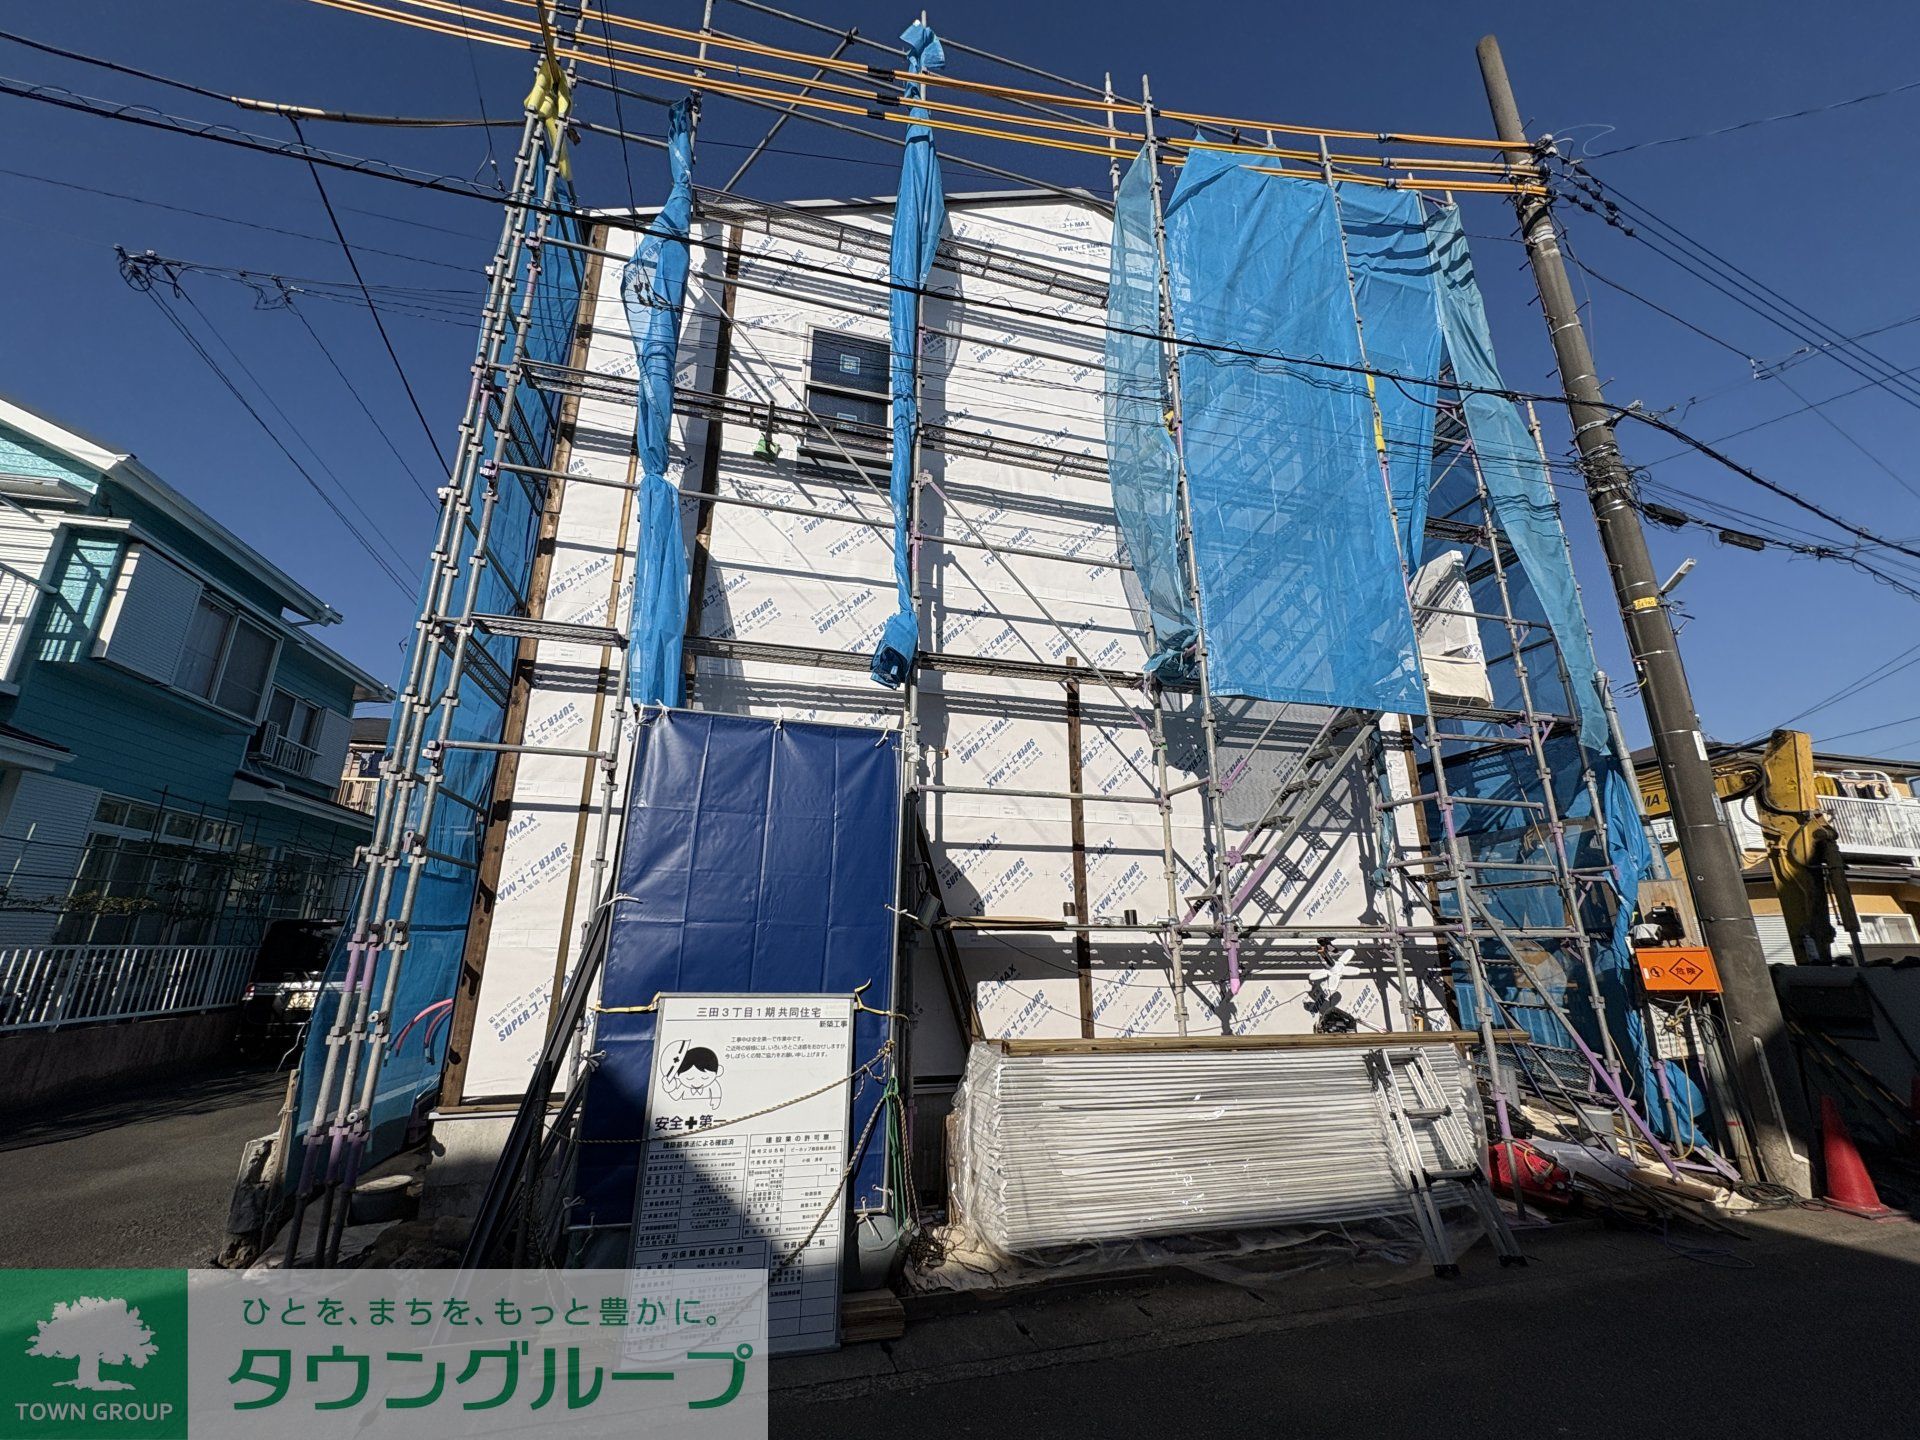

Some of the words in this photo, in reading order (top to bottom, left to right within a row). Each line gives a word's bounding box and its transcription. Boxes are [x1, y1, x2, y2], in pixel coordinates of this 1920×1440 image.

[497, 842, 568, 901] SUPERコートMA
[819, 1020, 848, 1028] 新築工事
[654, 1115, 683, 1131] 安全
